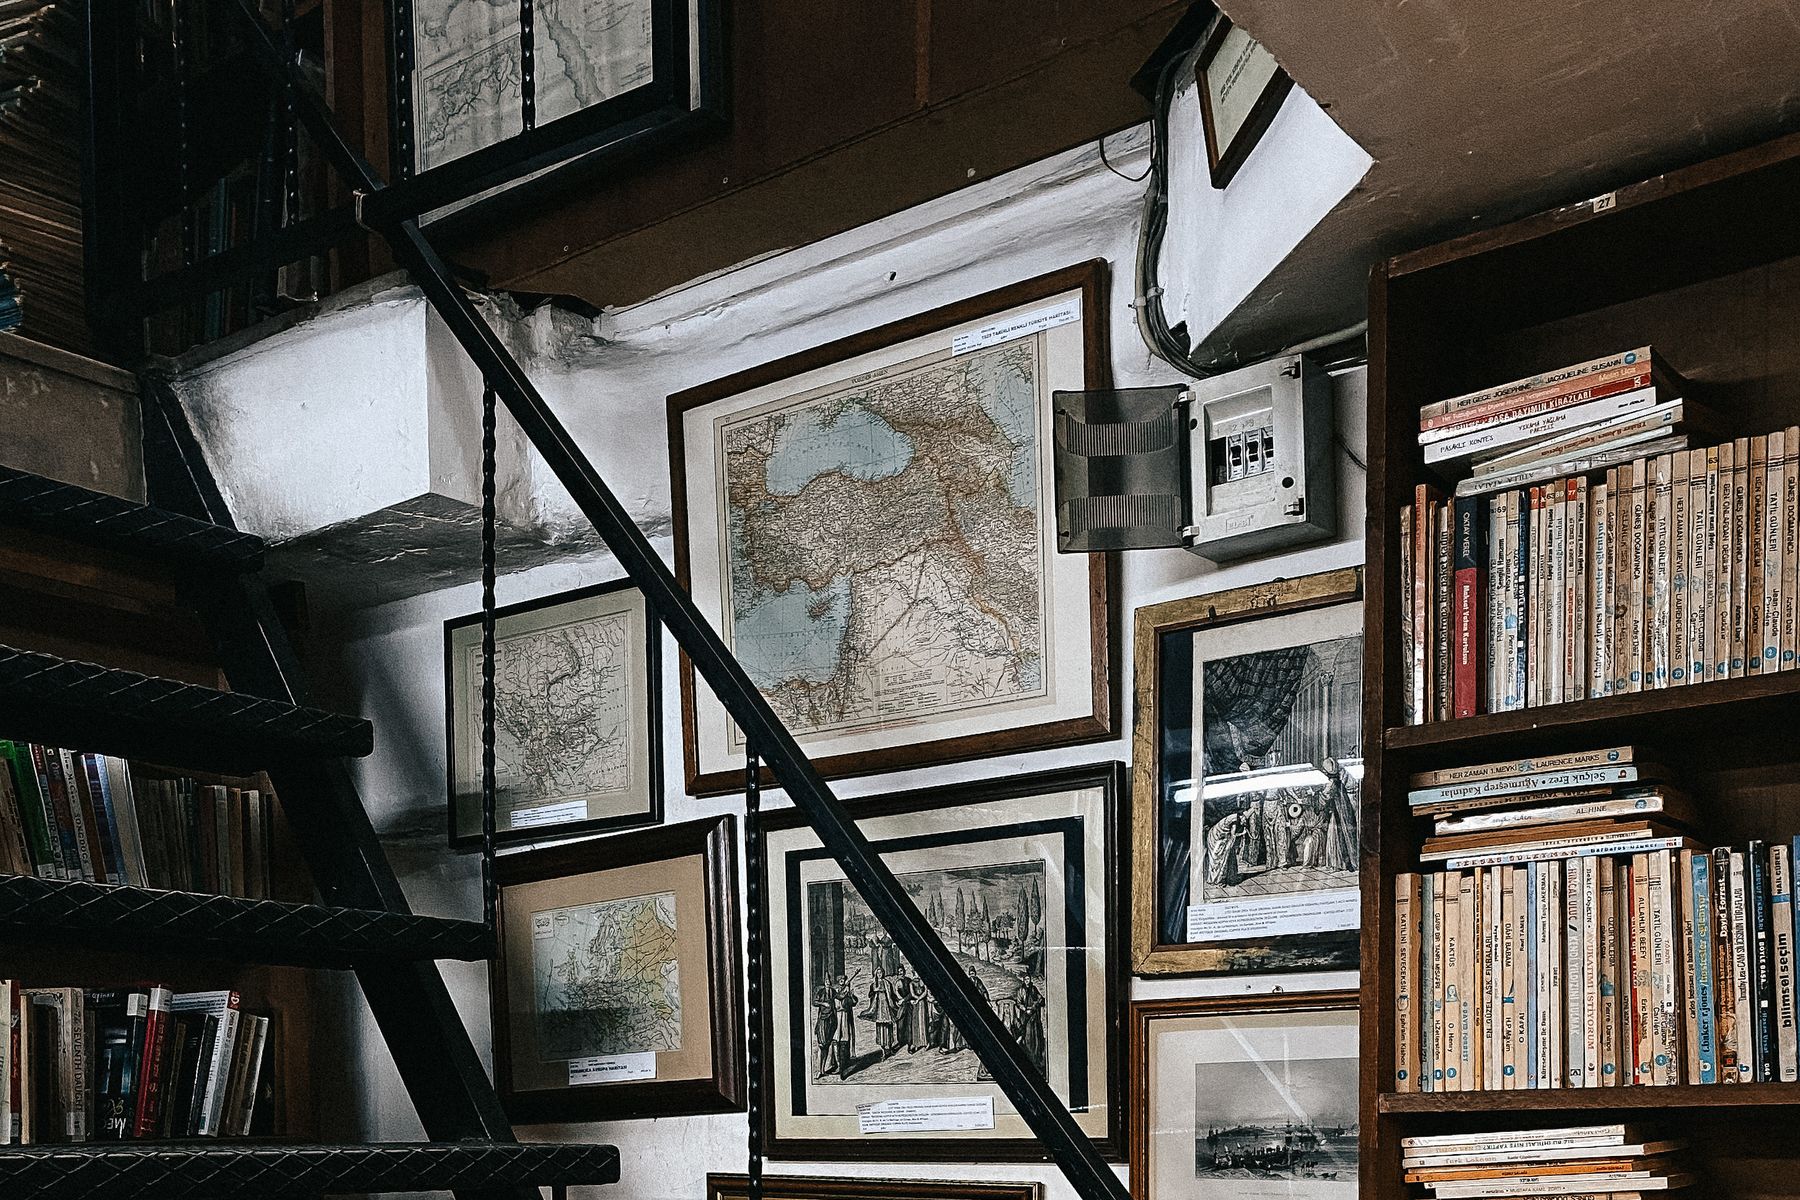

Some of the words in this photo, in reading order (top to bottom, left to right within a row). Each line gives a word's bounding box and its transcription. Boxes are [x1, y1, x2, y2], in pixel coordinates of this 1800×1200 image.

[1598, 197, 1611, 209] 27
[1457, 398, 1471, 408] HER
[1472, 394, 1491, 404] GECE
[1785, 475, 1796, 502] GÜNEŞ
[1769, 491, 1779, 515] TATİL
[1462, 512, 1470, 535] OKTAY
[1768, 515, 1779, 552] GÜNLERİ
[1786, 505, 1797, 555] DOĞMAYINCA
[1462, 535, 1470, 558] VEREL
[1674, 593, 1683, 633] LAURENCE
[1674, 633, 1683, 661] MARKS
[1536, 757, 1573, 768] LAURENCE
[1575, 754, 1600, 763] MARKS
[1483, 778, 1539, 794] Ağırmeşrep
[1548, 776, 1570, 787] Erez
[1571, 770, 1606, 784] Selçuk
[1440, 786, 1482, 800] Kadınlar
[1718, 912, 1728, 937] David
[1448, 937, 1457, 968] KAKTÜS
[1505, 941, 1513, 968] BABAM
[1639, 936, 1648, 960] BEEFY
[1777, 932, 1791, 973] seçim
[1399, 947, 1408, 993] SEVECEKSİN
[1779, 974, 1793, 1028] bilimsel
[1587, 991, 1596, 1050] İSTİYORUM
[73, 1027, 83, 1071] SEVENTH
[1447, 1032, 1455, 1053] Henry
